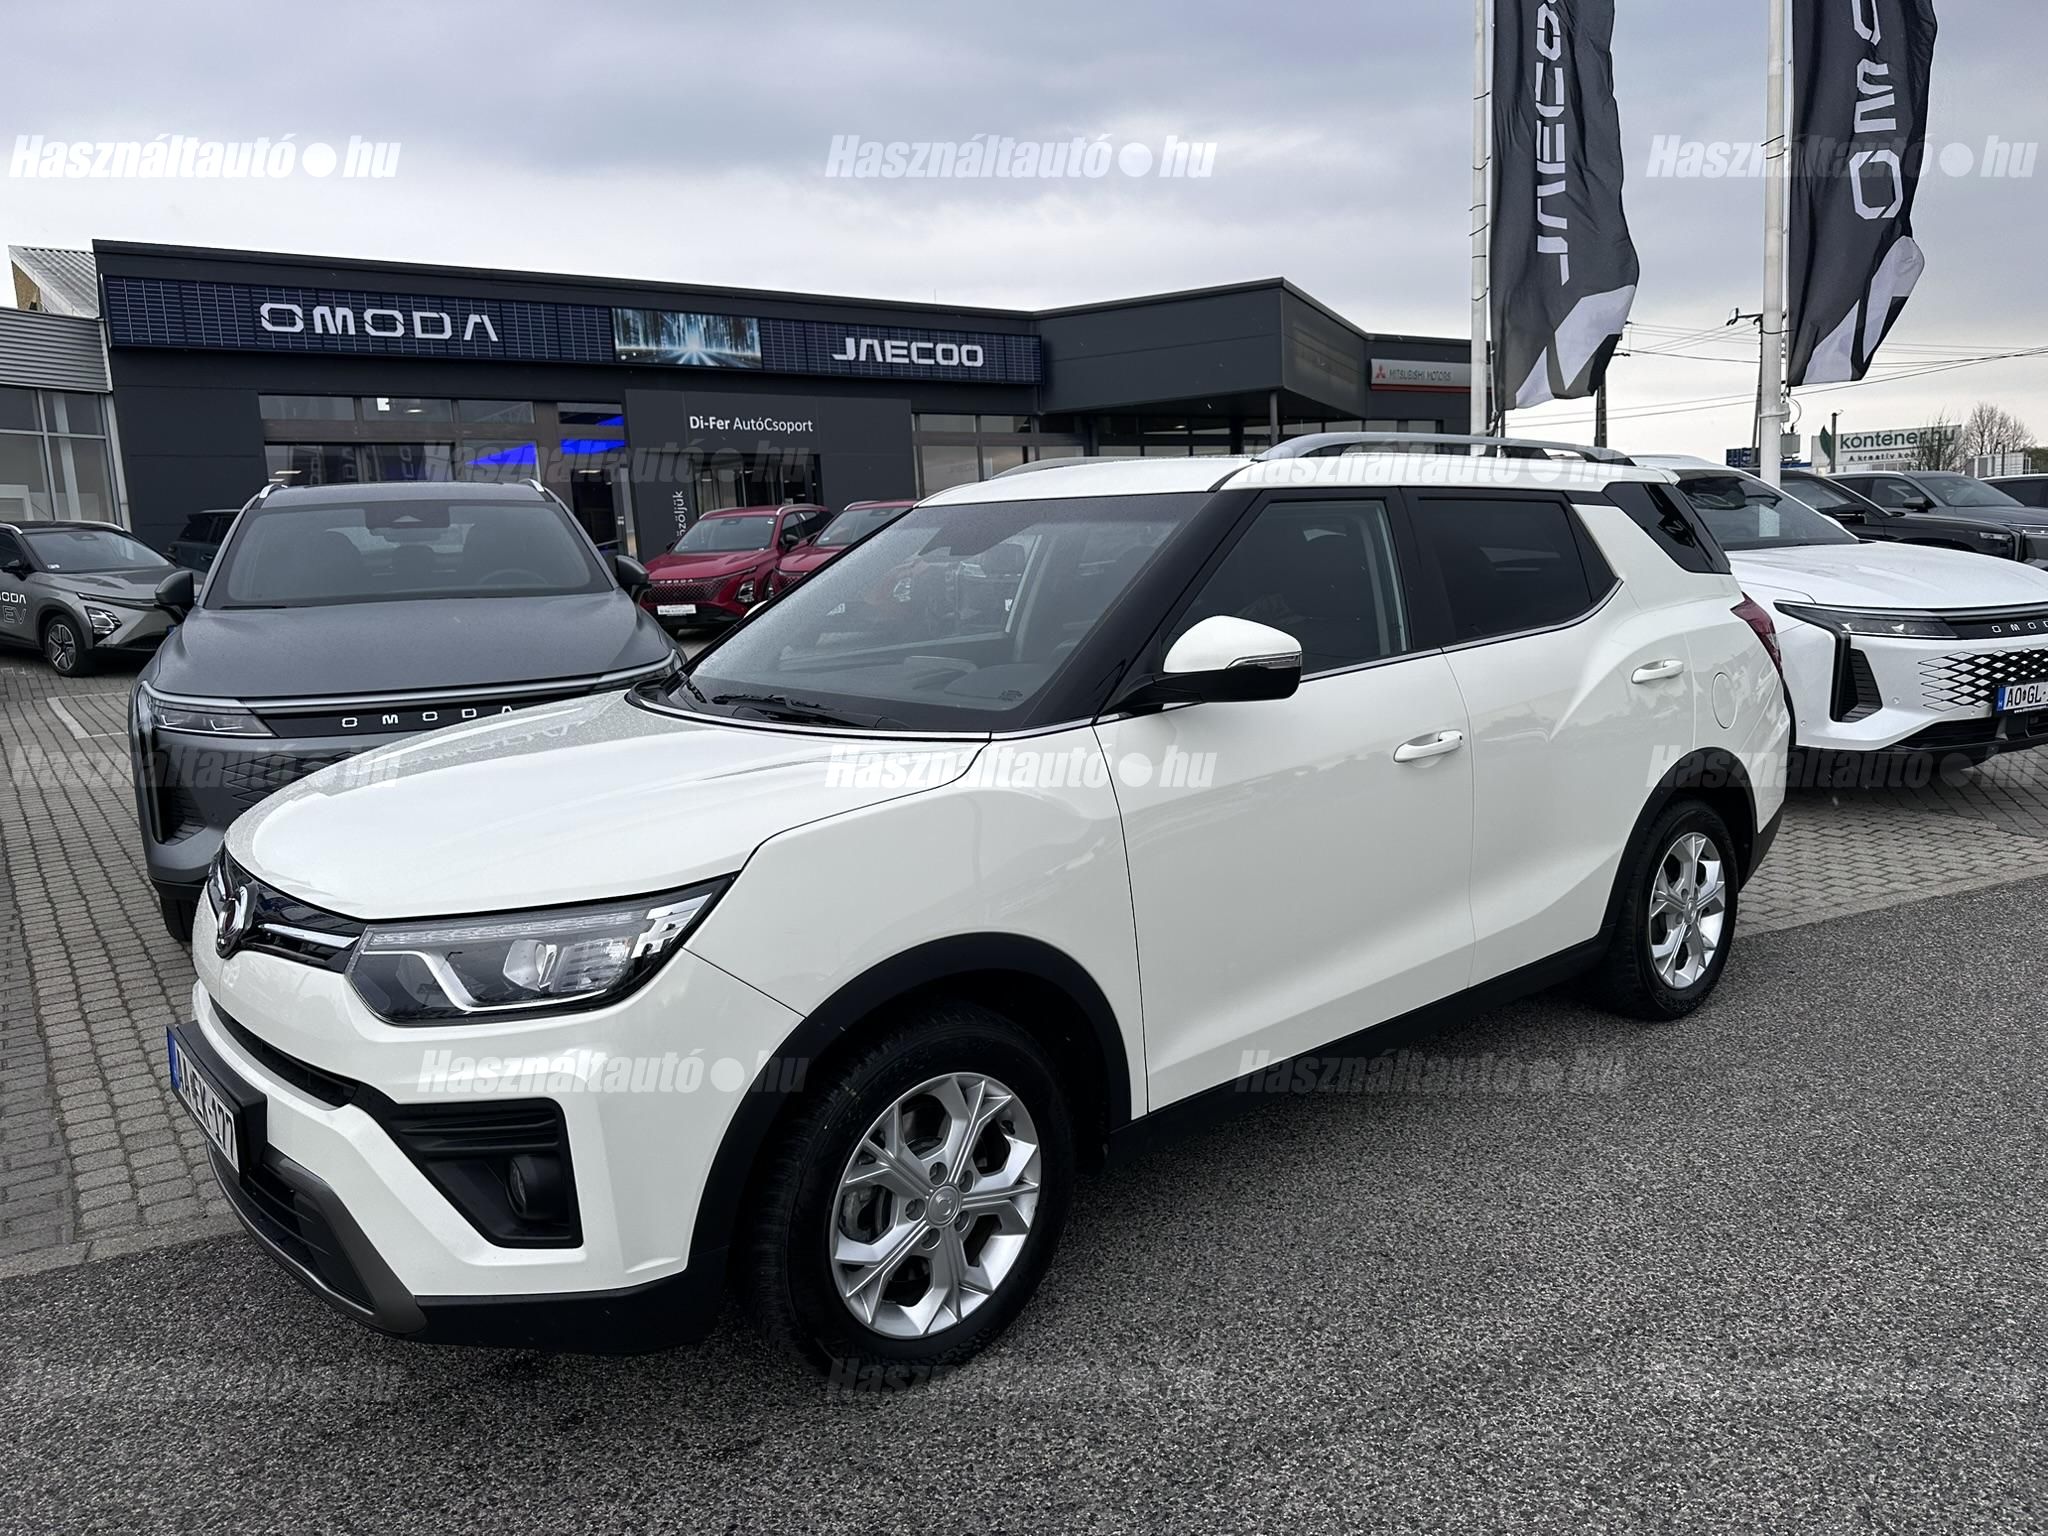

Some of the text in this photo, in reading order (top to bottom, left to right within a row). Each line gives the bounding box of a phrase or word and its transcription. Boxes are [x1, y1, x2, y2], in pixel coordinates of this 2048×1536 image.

[1535, 0, 1570, 286] JAECO
[260, 302, 499, 342] OMODA
[831, 337, 984, 367] JAECOO
[689, 415, 814, 434] Di-Fer AutóCsoport
[0, 591, 27, 605] ODA
